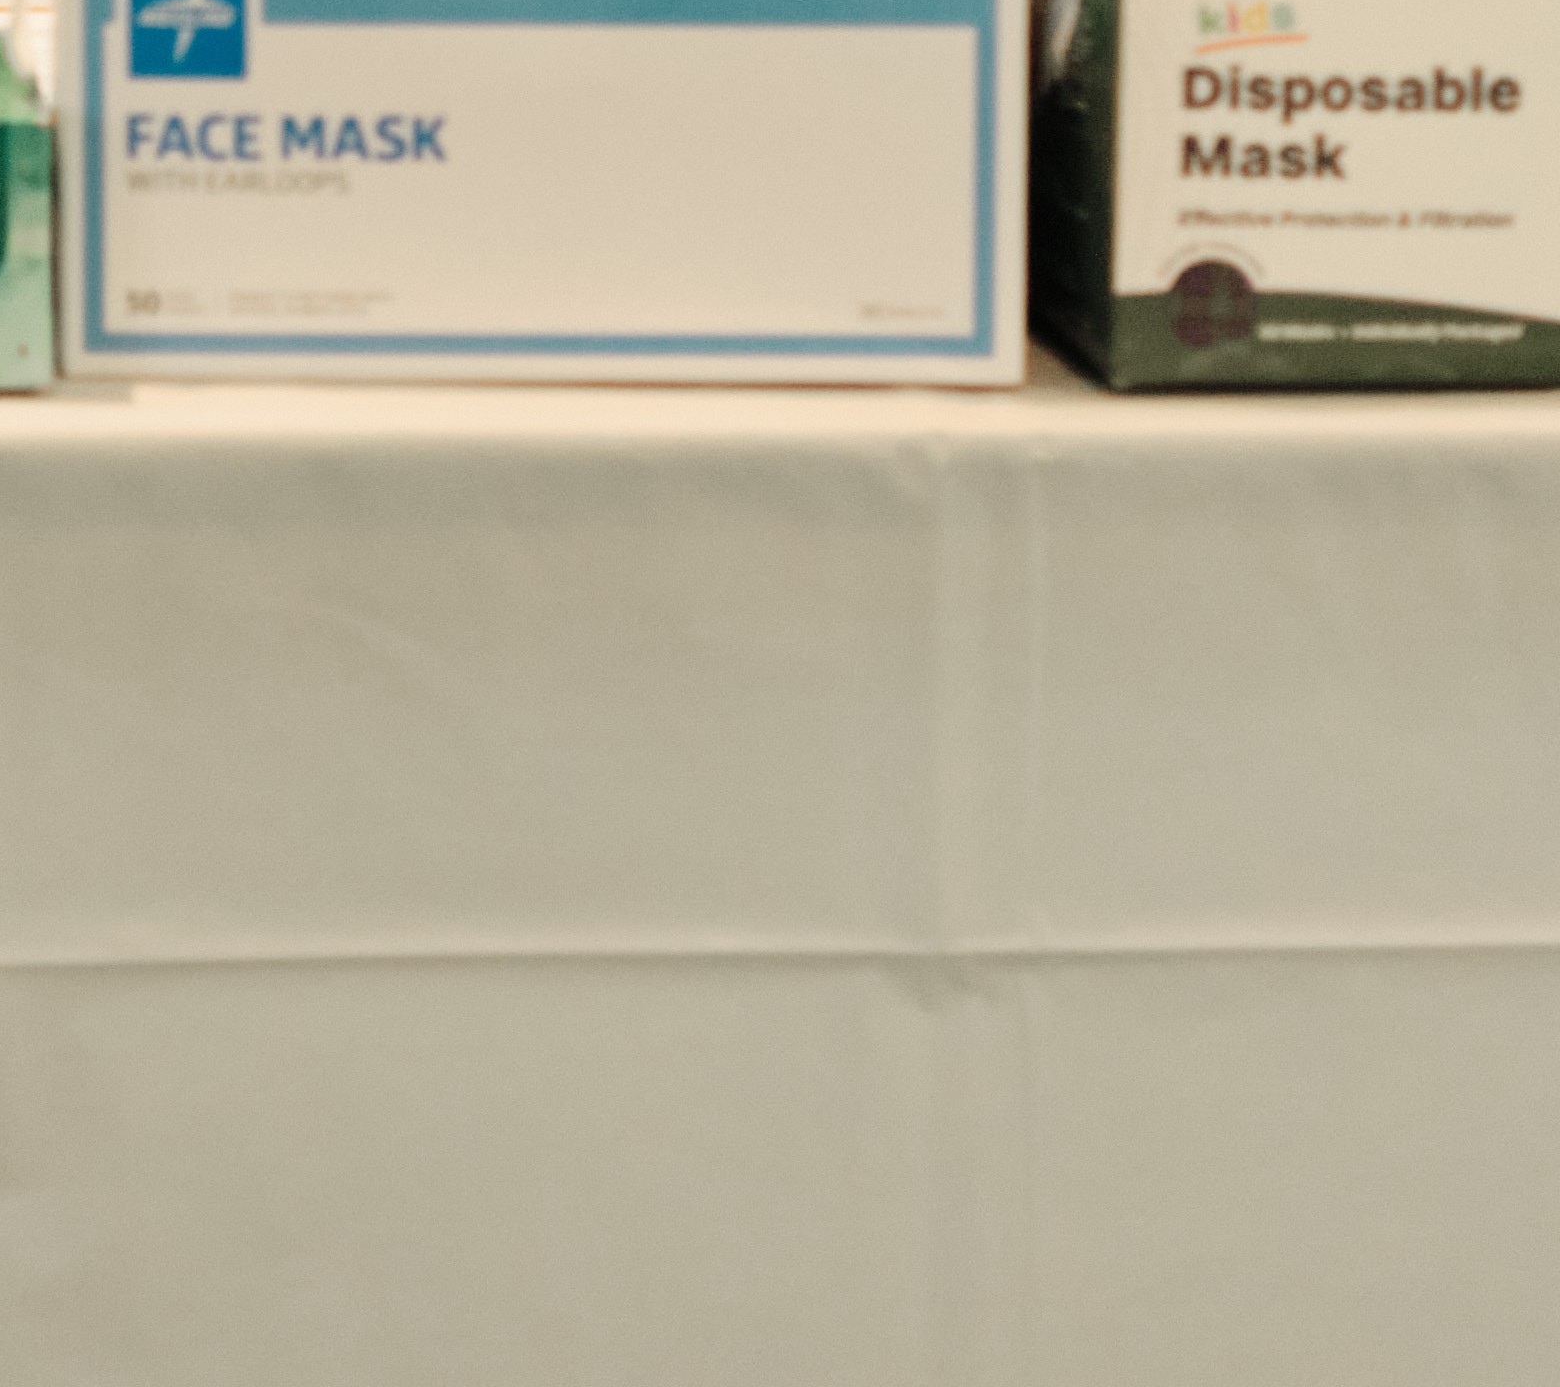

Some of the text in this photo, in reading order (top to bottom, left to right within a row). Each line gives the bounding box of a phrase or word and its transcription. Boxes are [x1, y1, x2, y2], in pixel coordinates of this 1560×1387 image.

[1199, 0, 1295, 34] kids
[1181, 64, 1522, 125] Disposable
[125, 114, 448, 162] FACE MASK
[1180, 134, 1348, 181] Mask
[126, 288, 161, 315] 50
